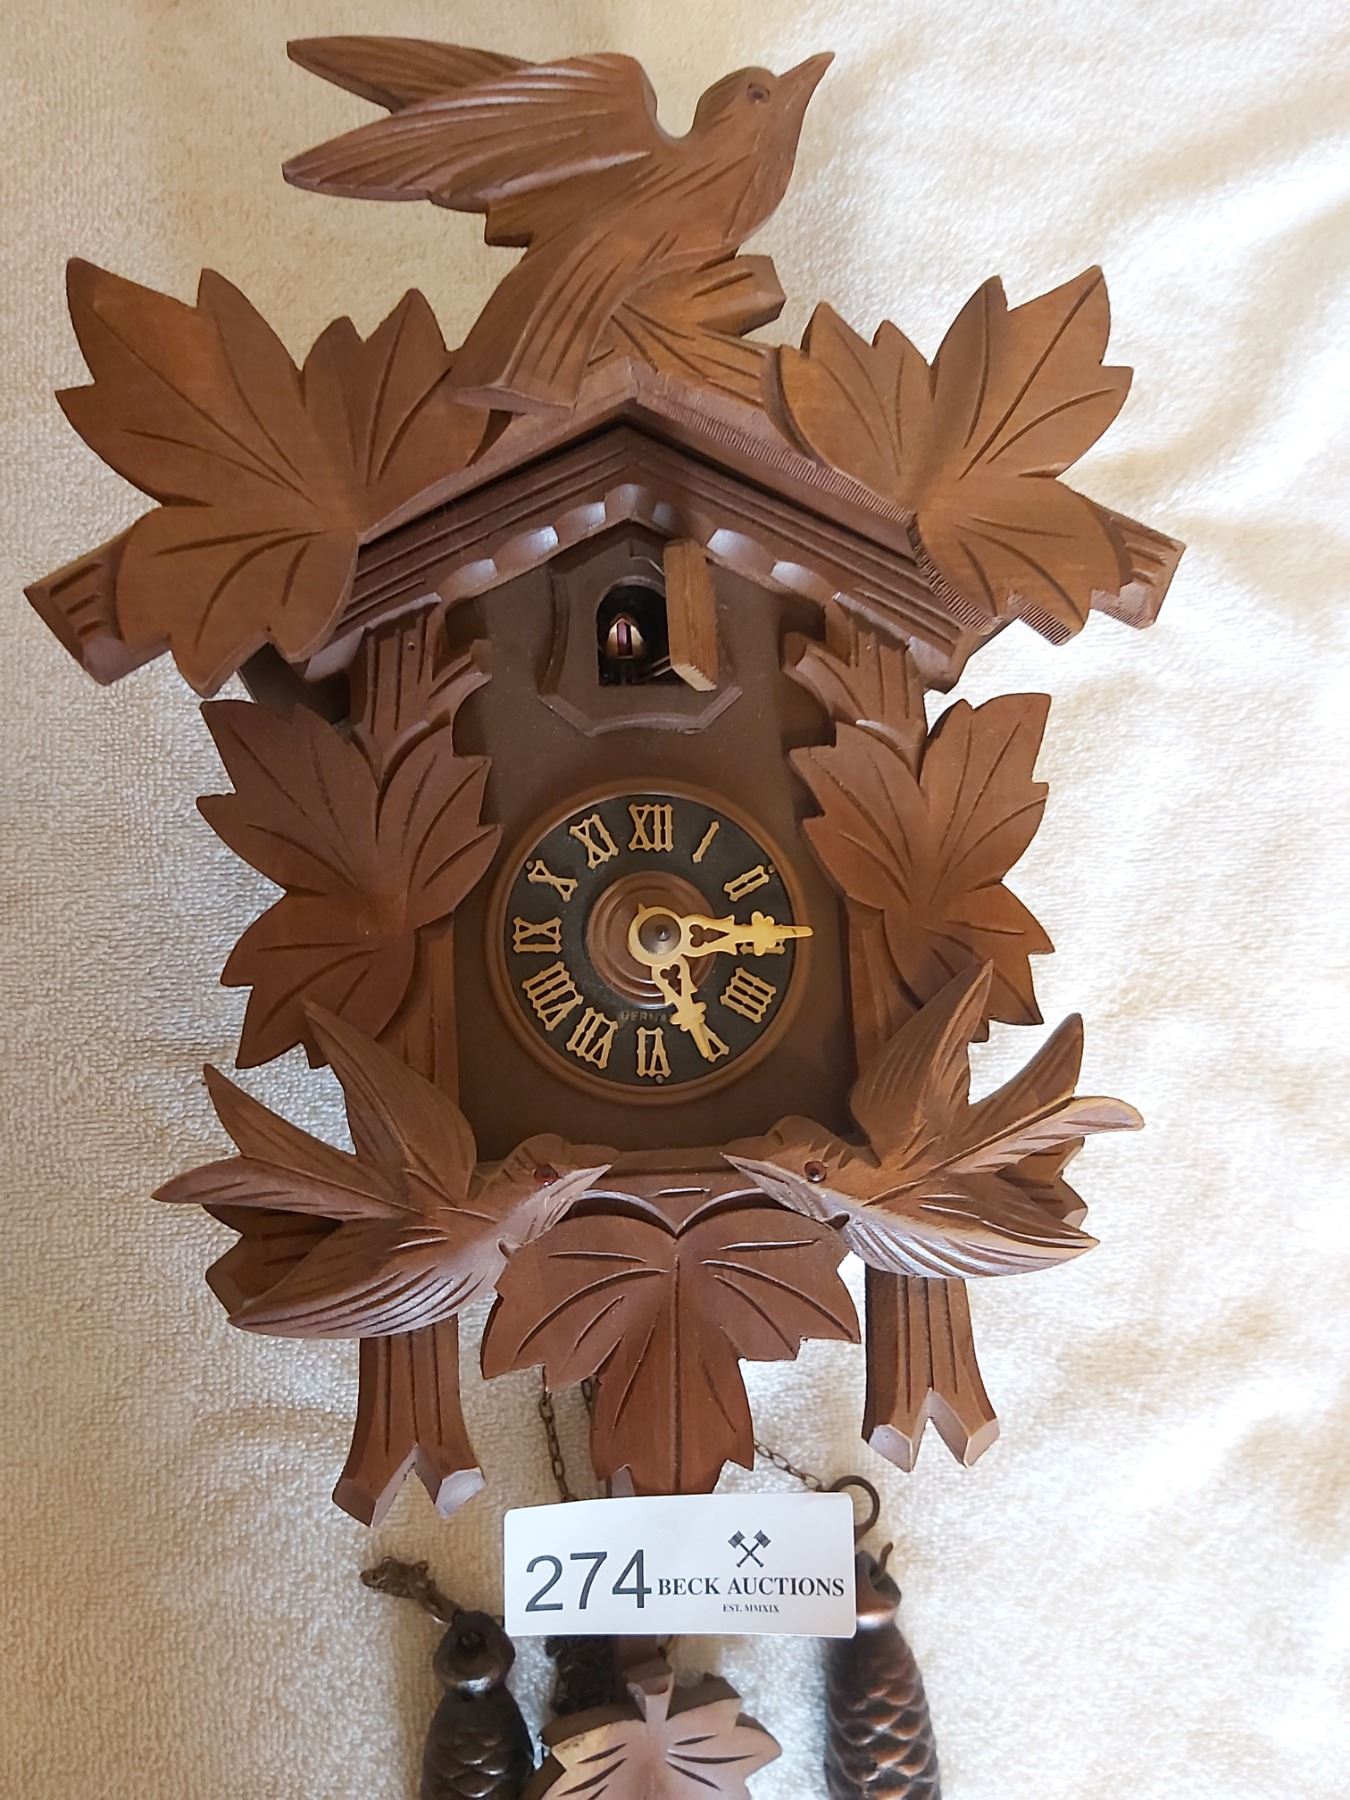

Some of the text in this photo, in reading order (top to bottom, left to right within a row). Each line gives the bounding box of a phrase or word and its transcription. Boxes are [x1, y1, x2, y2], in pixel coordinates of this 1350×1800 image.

[569, 813, 619, 869] XI
[628, 803, 673, 852] XII
[692, 821, 720, 863] I
[527, 859, 579, 902] X
[723, 865, 770, 902] II
[512, 916, 562, 954] IX
[521, 961, 584, 1031] VIII
[720, 966, 776, 1024] IIII
[566, 1006, 619, 1069] VII
[636, 1026, 672, 1078] VI
[525, 1549, 651, 1612] 274
[657, 1576, 845, 1597] BECK AUCTIONS
[722, 1603, 780, 1614] EST. MMXIX
